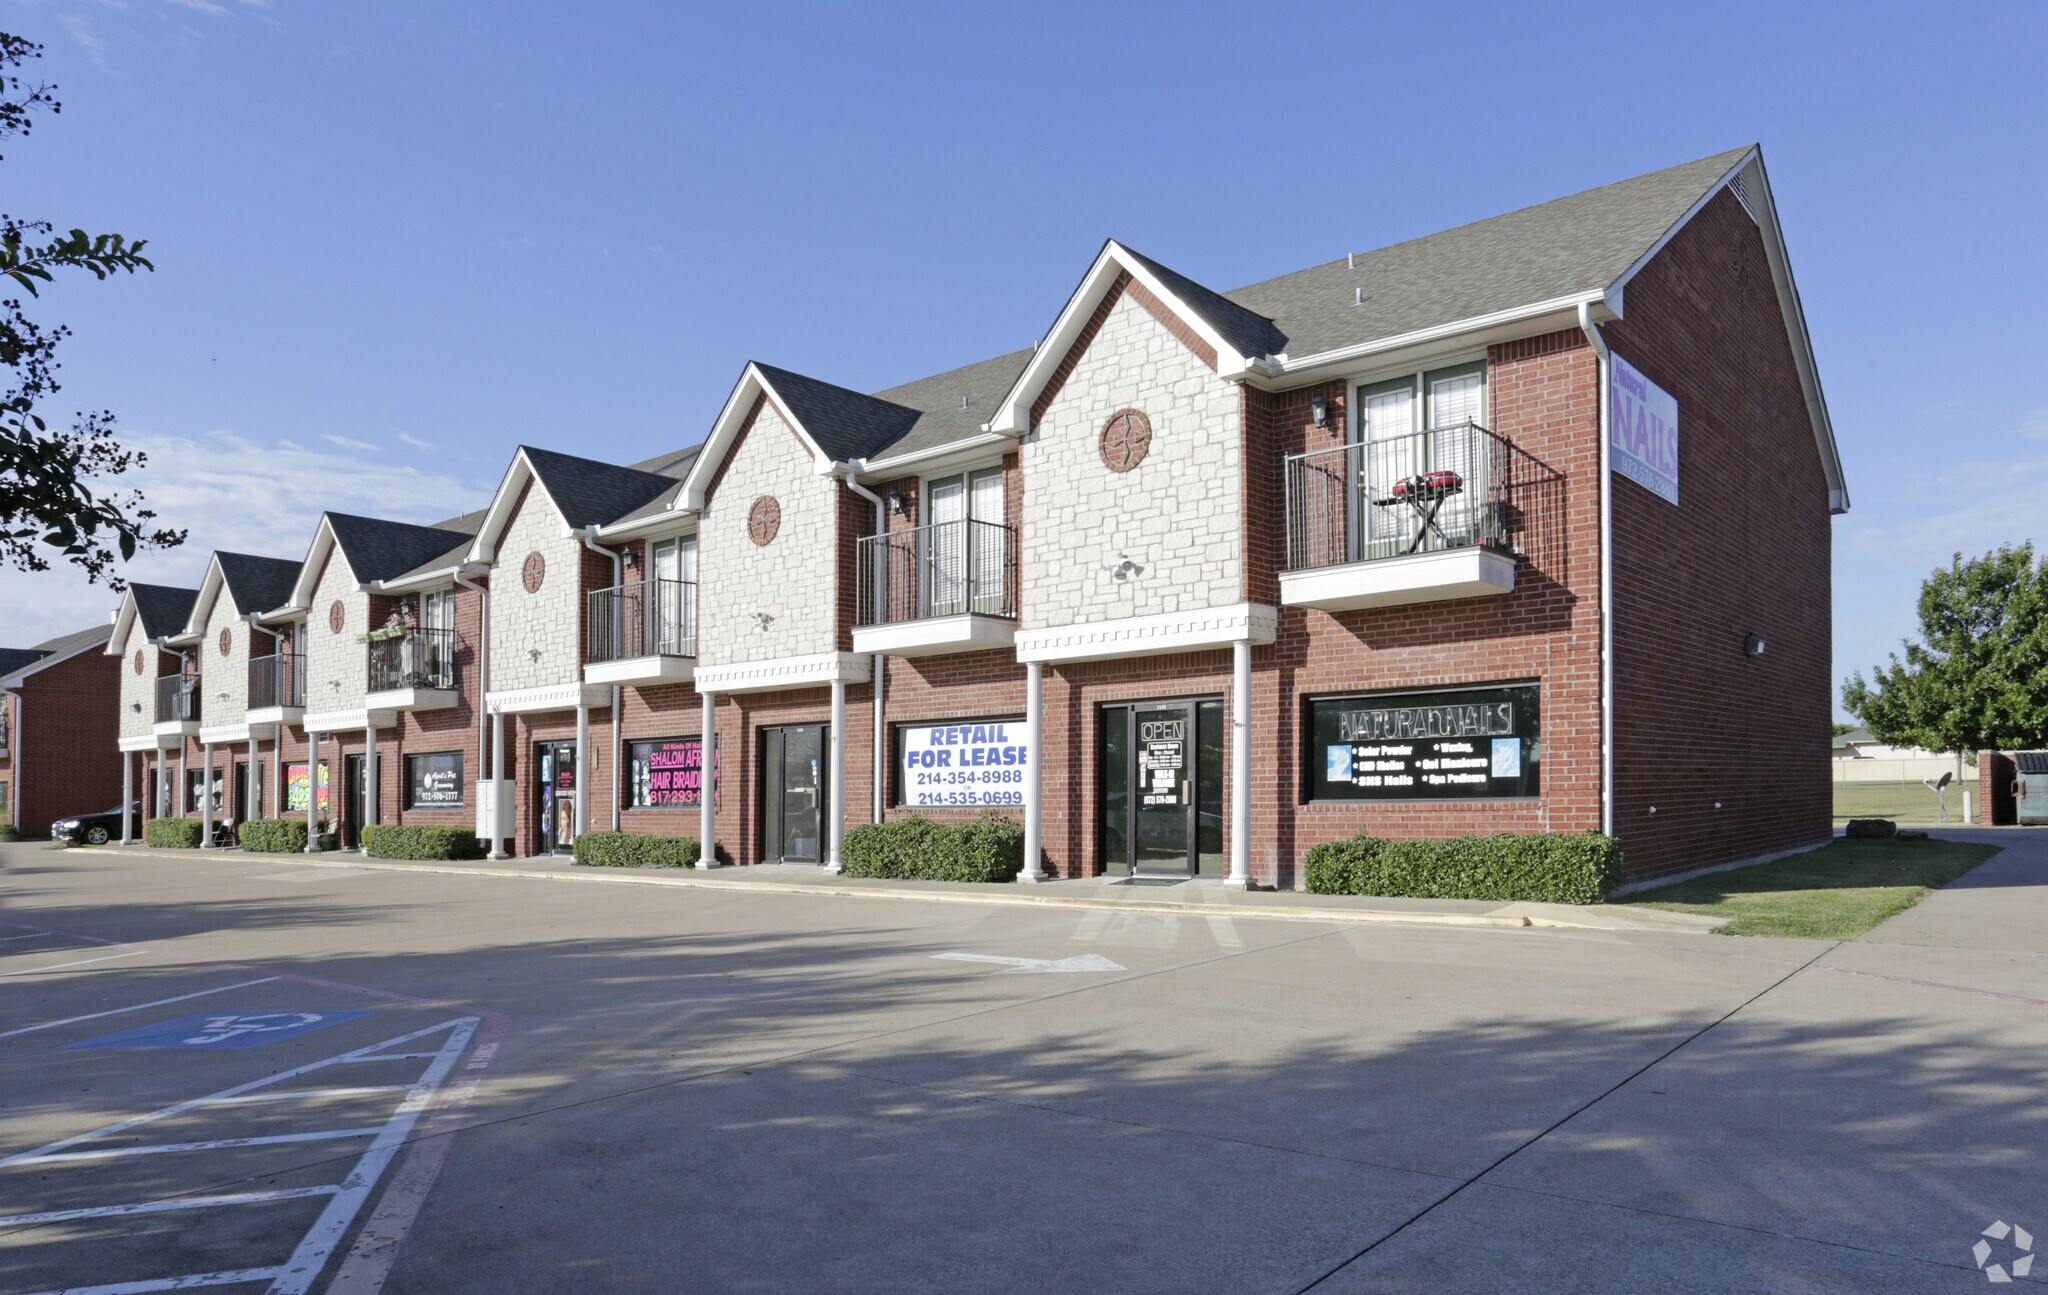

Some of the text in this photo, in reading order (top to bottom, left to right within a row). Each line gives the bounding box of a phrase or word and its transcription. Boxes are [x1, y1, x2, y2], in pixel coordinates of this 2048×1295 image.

[1615, 359, 1647, 402] Natural
[1612, 385, 1677, 480] NAILS
[1621, 455, 1674, 499] 972-576-2880
[1447, 702, 1512, 736] NAILS
[930, 725, 1008, 746] RETAIL
[1143, 722, 1183, 739] OPEN
[650, 751, 684, 766] SHALOM
[908, 746, 1027, 768] FOR LEASE
[1358, 745, 1413, 757] Solar Powder
[1422, 757, 1488, 769] Gel Manicure
[650, 772, 671, 789] HAIR
[917, 770, 1022, 785] 214-354-8988
[1358, 775, 1414, 786] SNS Nails
[1429, 773, 1487, 785] Spa Pedicure
[918, 791, 1023, 804] 214-535-0699
